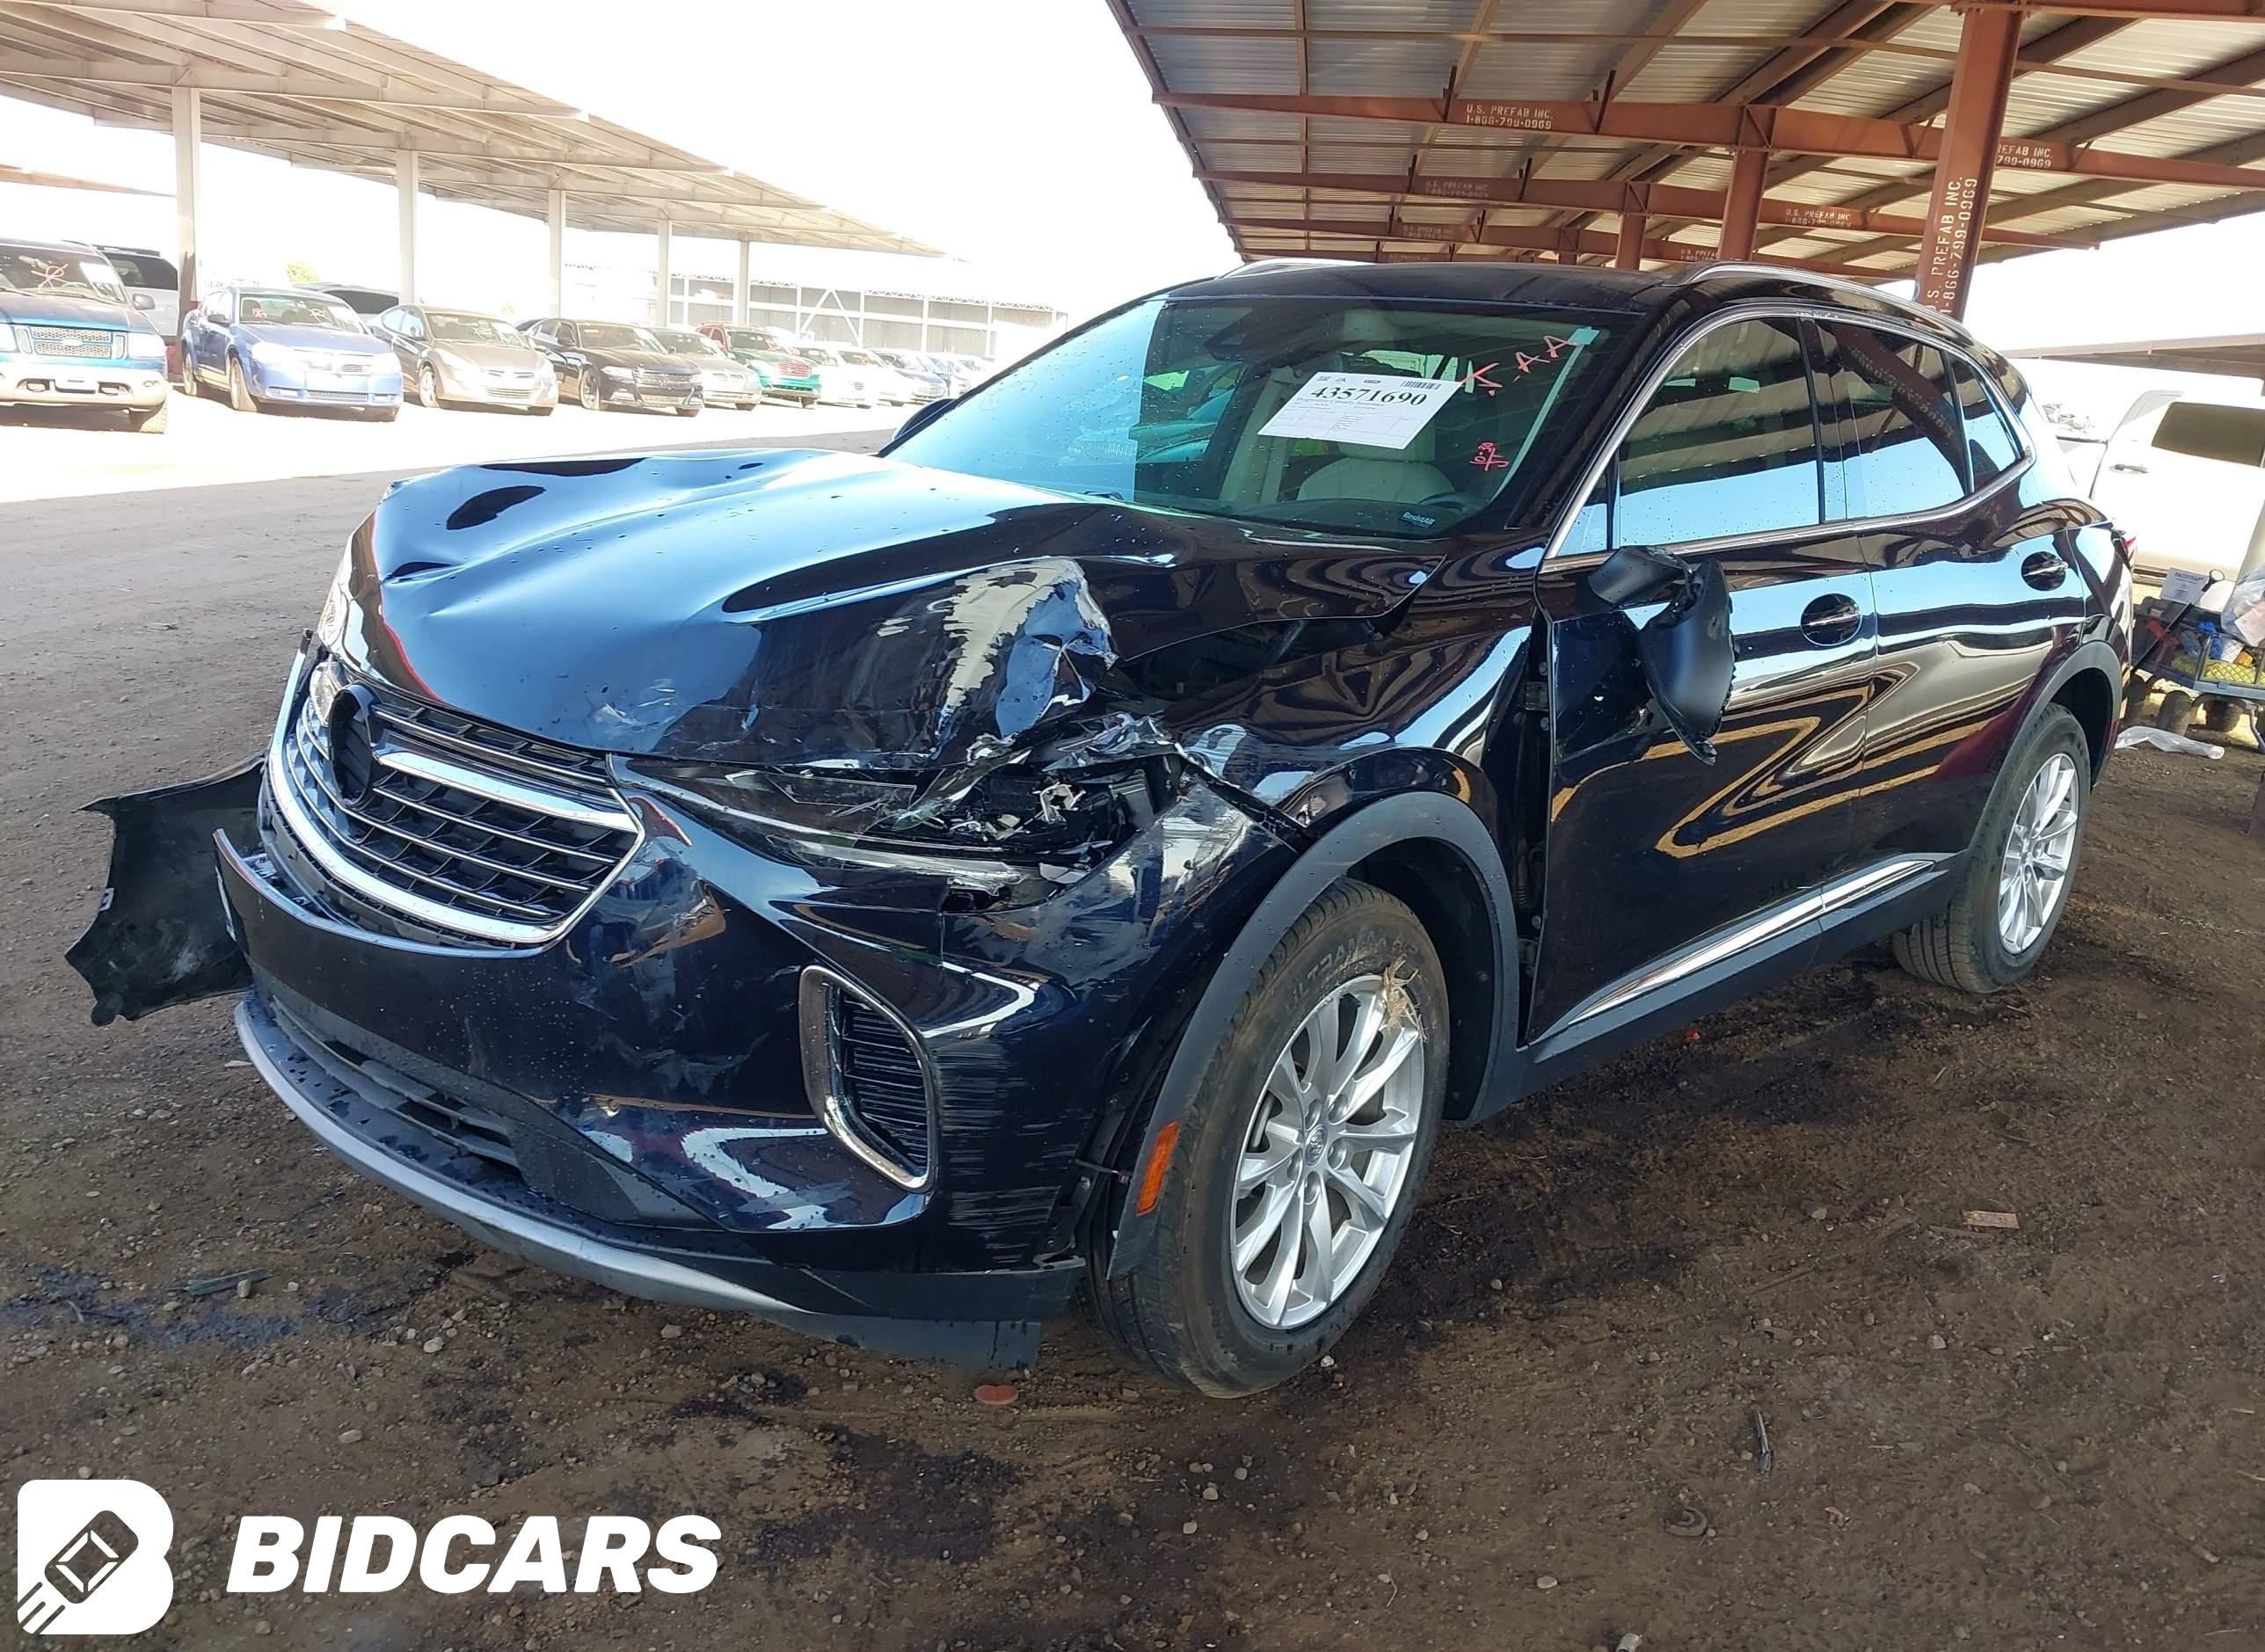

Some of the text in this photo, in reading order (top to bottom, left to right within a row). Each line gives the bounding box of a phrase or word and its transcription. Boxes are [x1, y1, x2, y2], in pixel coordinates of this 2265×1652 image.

[1466, 104, 1554, 120] U.S. PREFAB INC.
[1998, 143, 2029, 156] REFAB
[1997, 155, 2051, 169] 799-0969
[1931, 215, 1955, 275] PREFAB
[1944, 177, 1963, 206] INC.
[1940, 178, 1977, 313] 1-866-799-0969
[1311, 386, 1428, 406] 43571690
